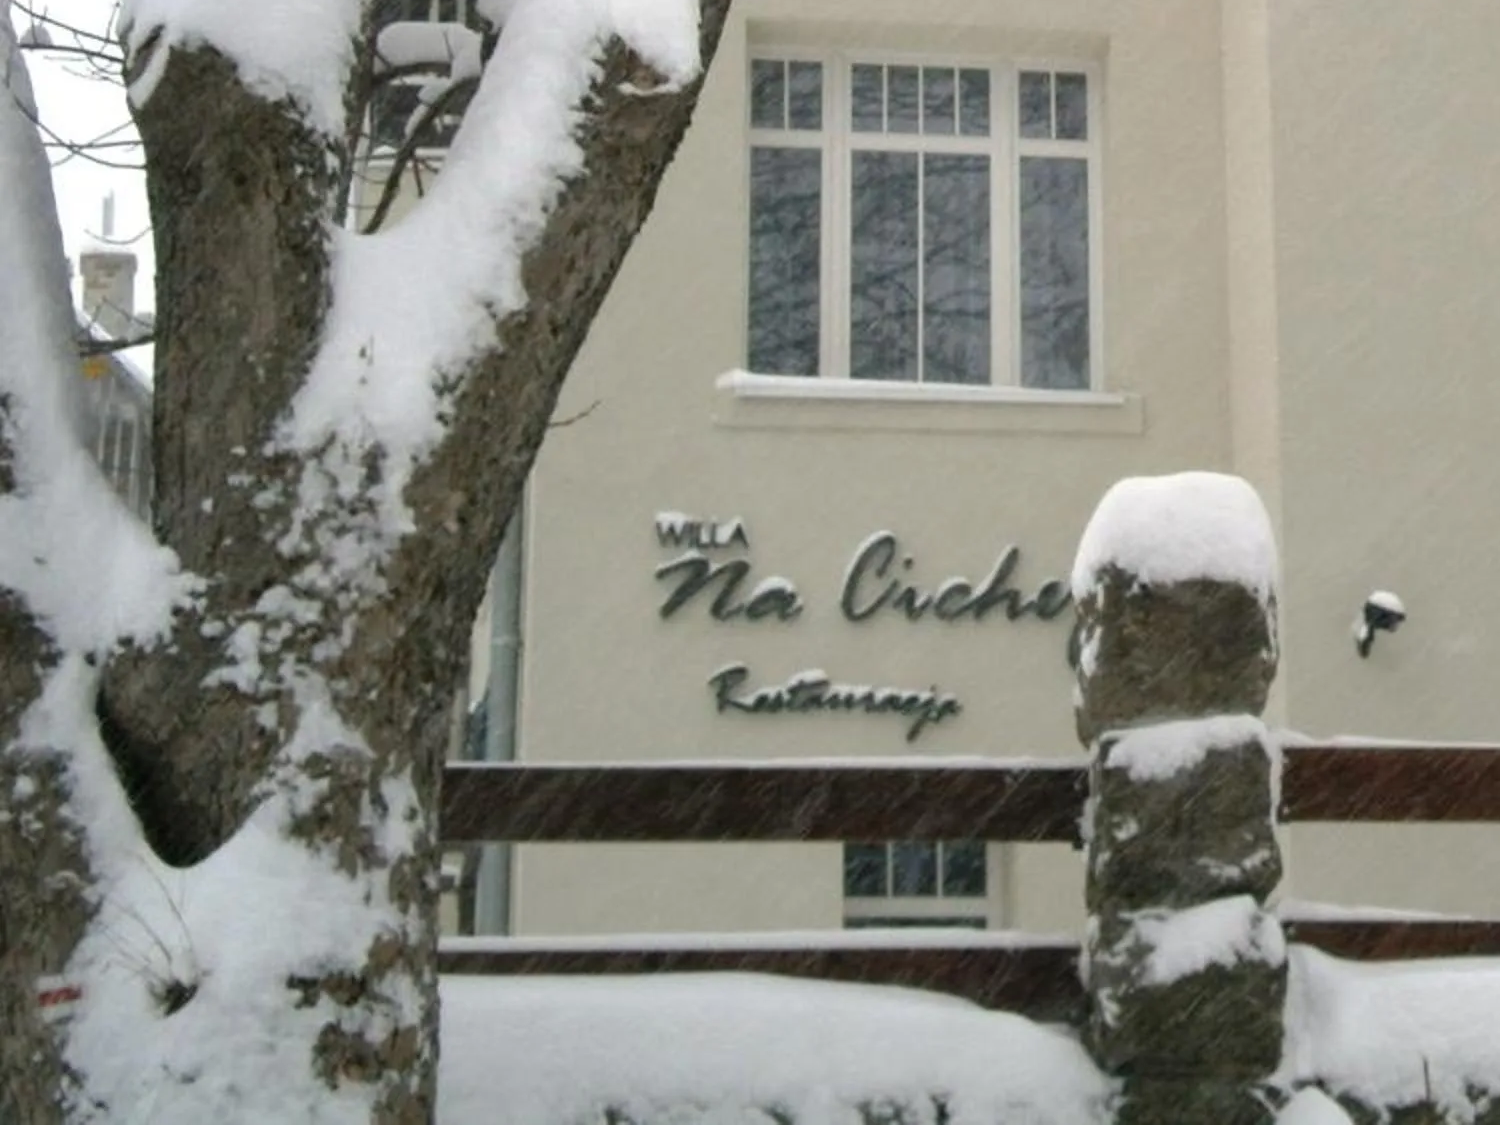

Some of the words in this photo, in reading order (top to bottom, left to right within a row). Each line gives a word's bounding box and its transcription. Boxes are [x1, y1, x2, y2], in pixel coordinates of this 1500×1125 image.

[655, 515, 750, 549] WILLA
[655, 554, 803, 621] Na
[708, 663, 961, 743] Restauracja
